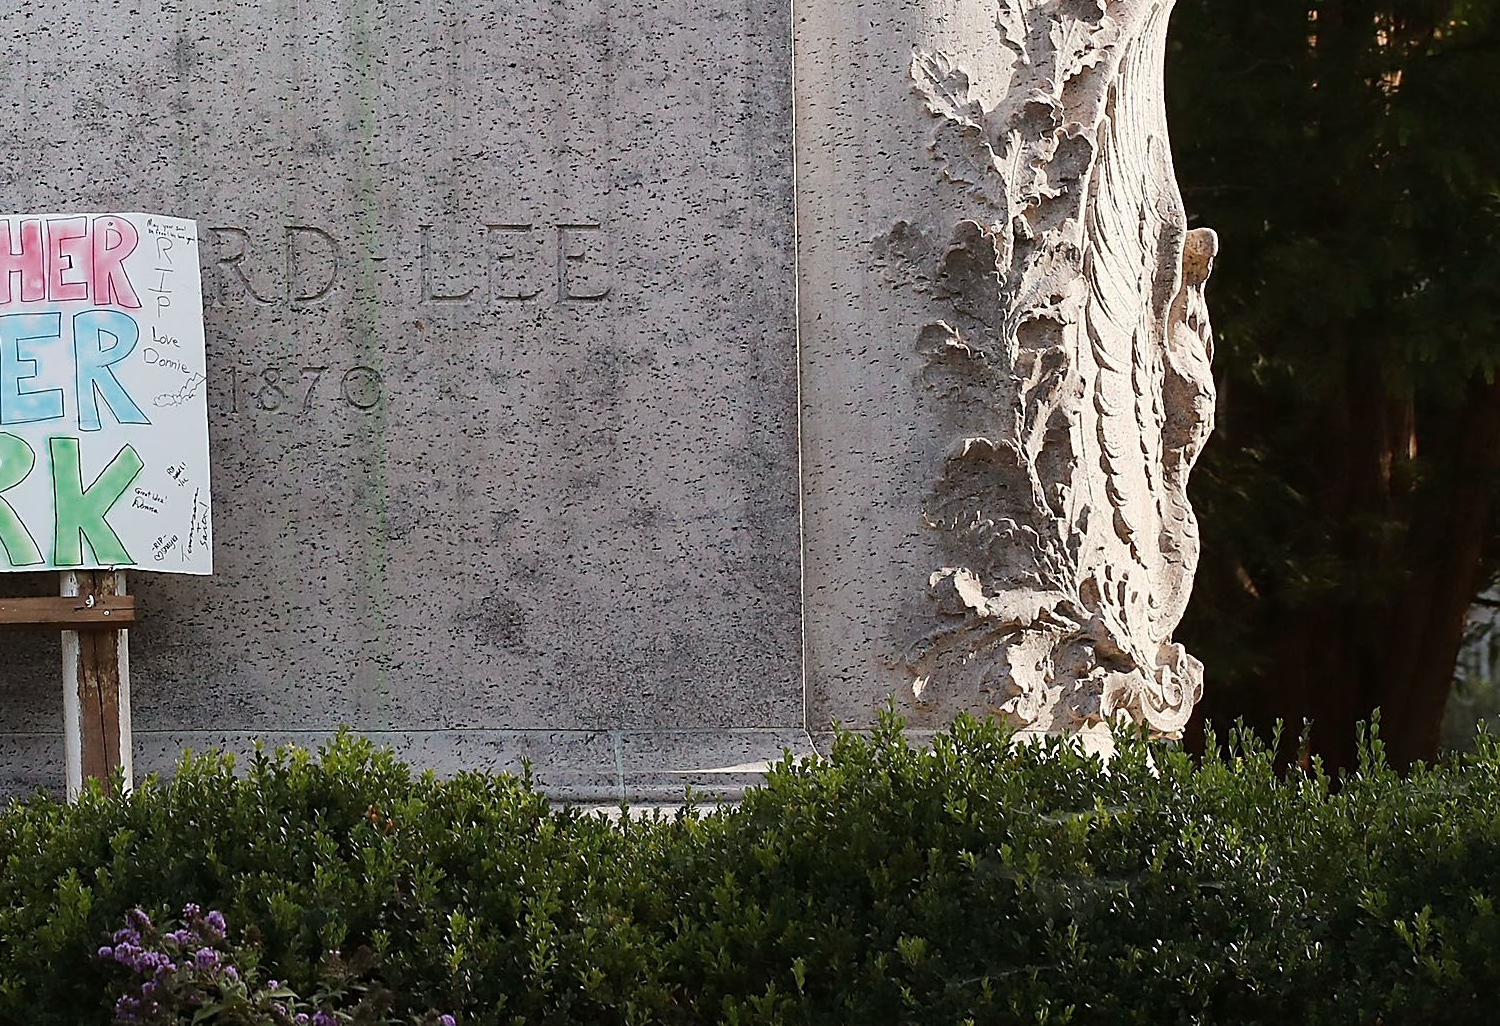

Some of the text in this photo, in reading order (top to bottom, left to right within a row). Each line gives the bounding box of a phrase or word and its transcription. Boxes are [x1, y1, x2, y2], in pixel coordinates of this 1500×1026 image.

[209, 225, 339, 306] RD
[419, 223, 612, 305] LEE
[152, 326, 180, 348] Love
[143, 348, 191, 373] Donnie
